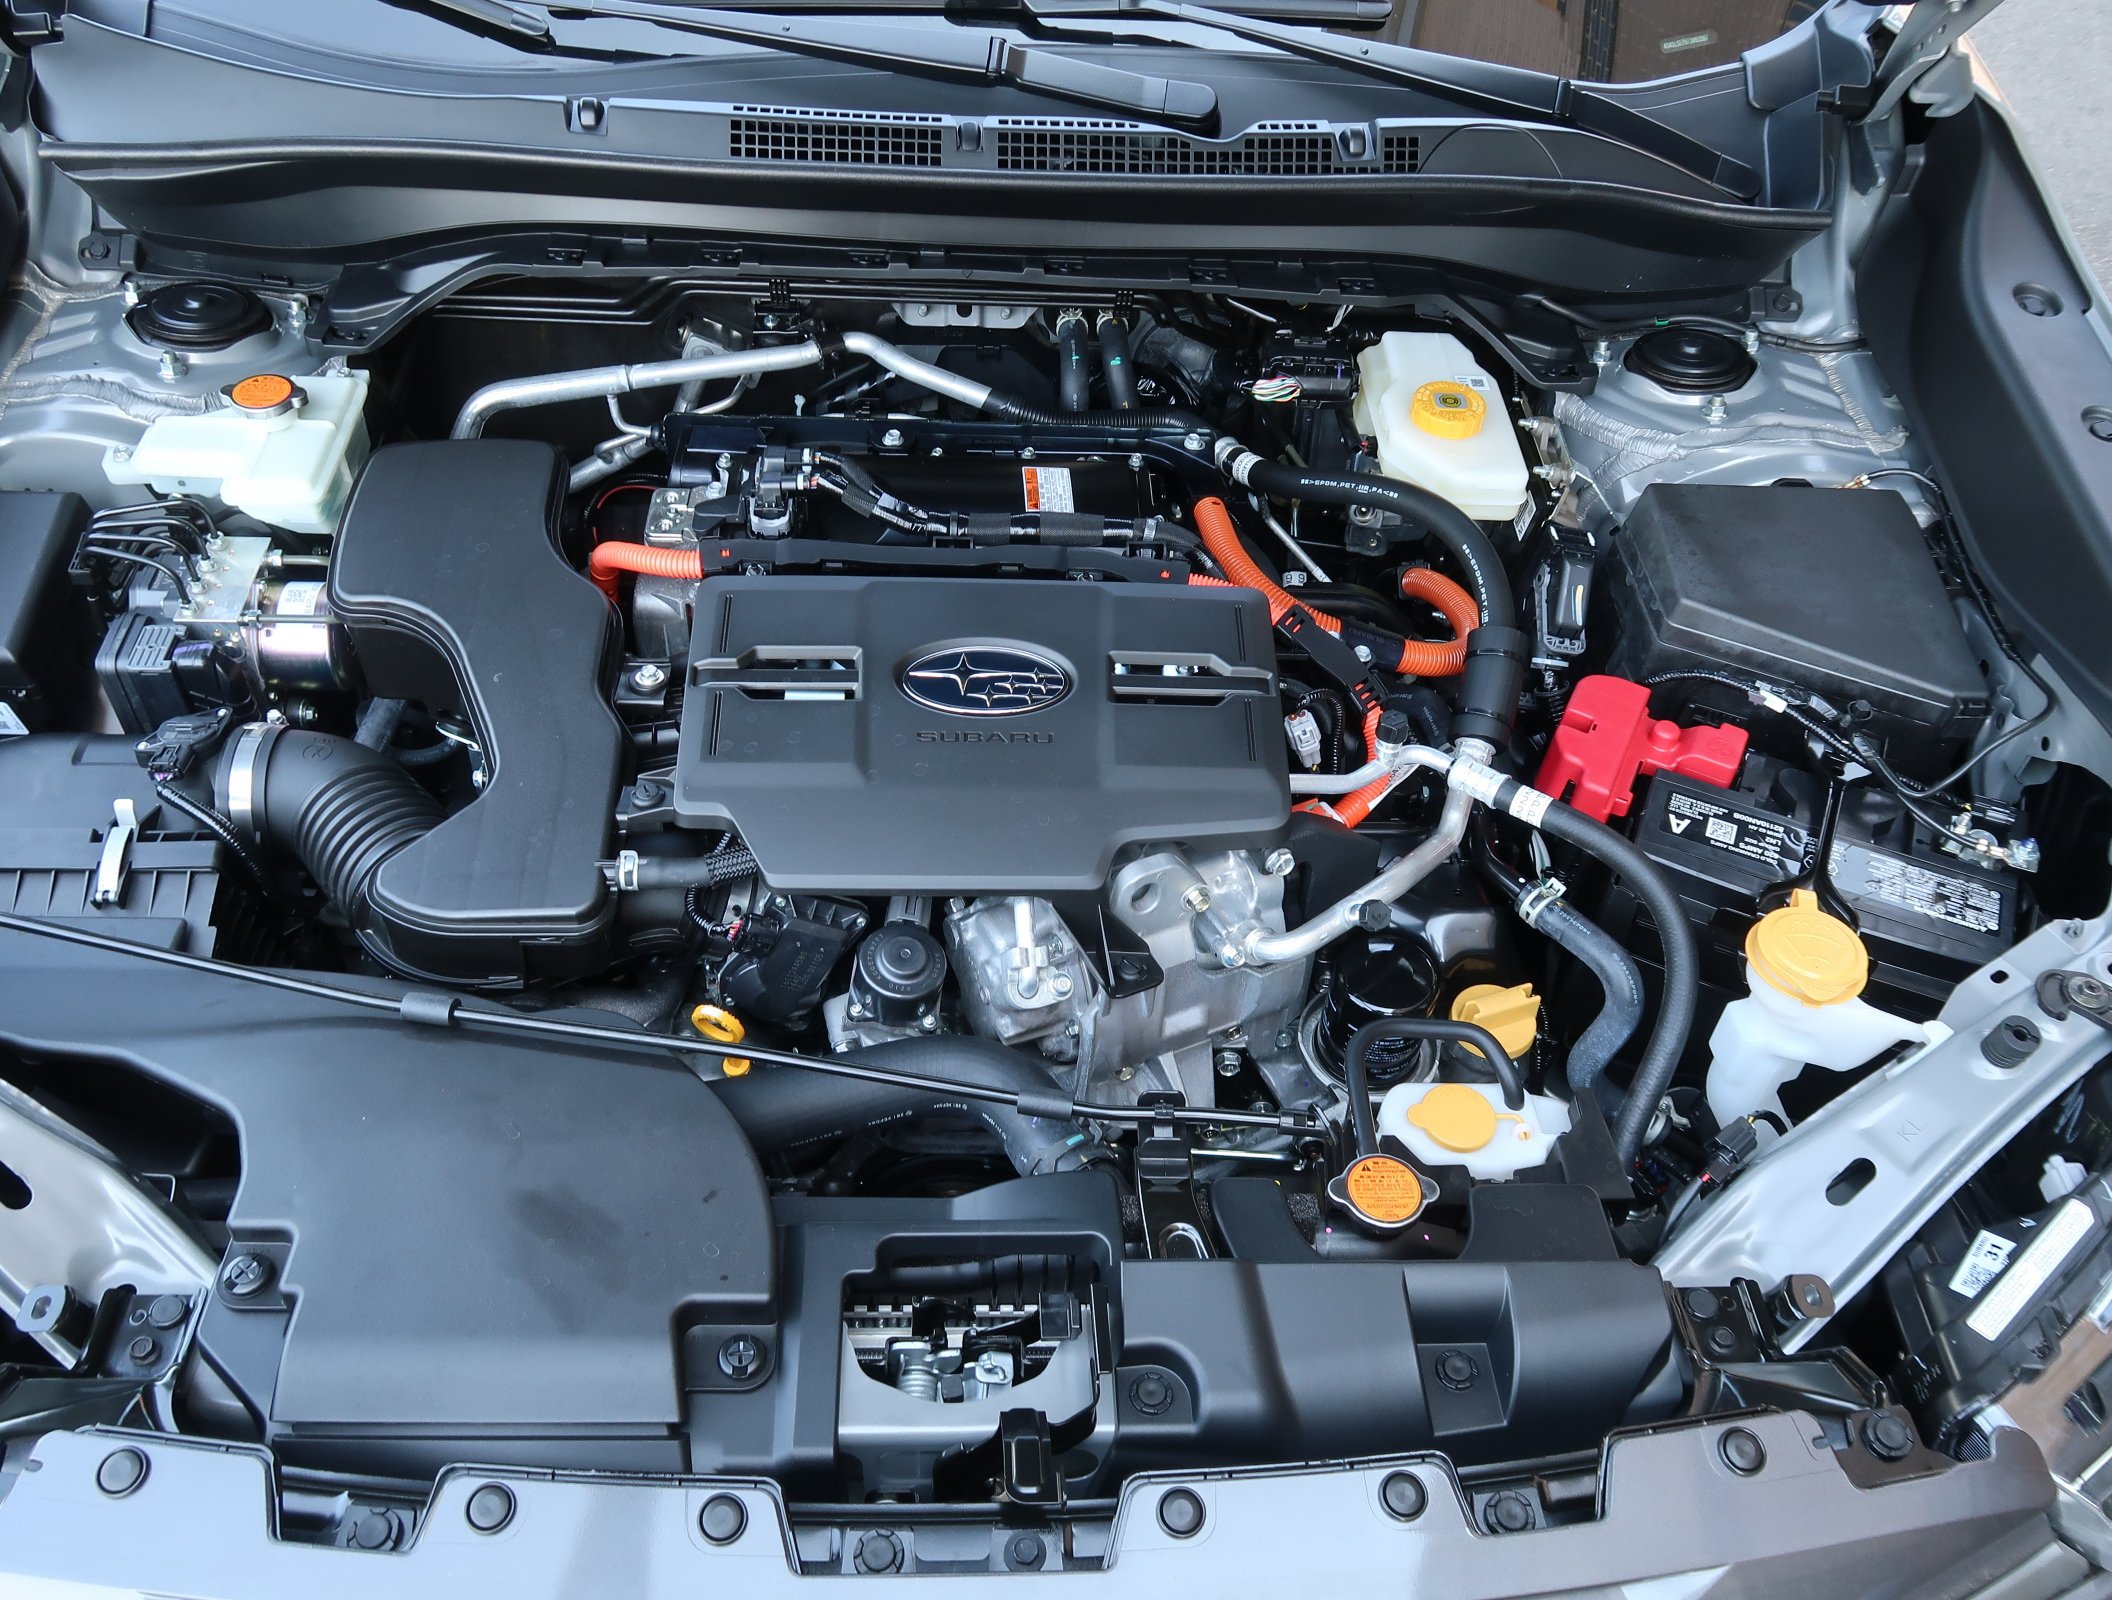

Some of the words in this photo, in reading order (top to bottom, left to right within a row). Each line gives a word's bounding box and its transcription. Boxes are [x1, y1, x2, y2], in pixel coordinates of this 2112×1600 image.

[916, 731, 1054, 744] SUBARU
[1668, 813, 1691, 834] A
[1738, 842, 1763, 855] AMPS
[1972, 1235, 1989, 1257] SUBARU
[1984, 1243, 2004, 1262] 31
